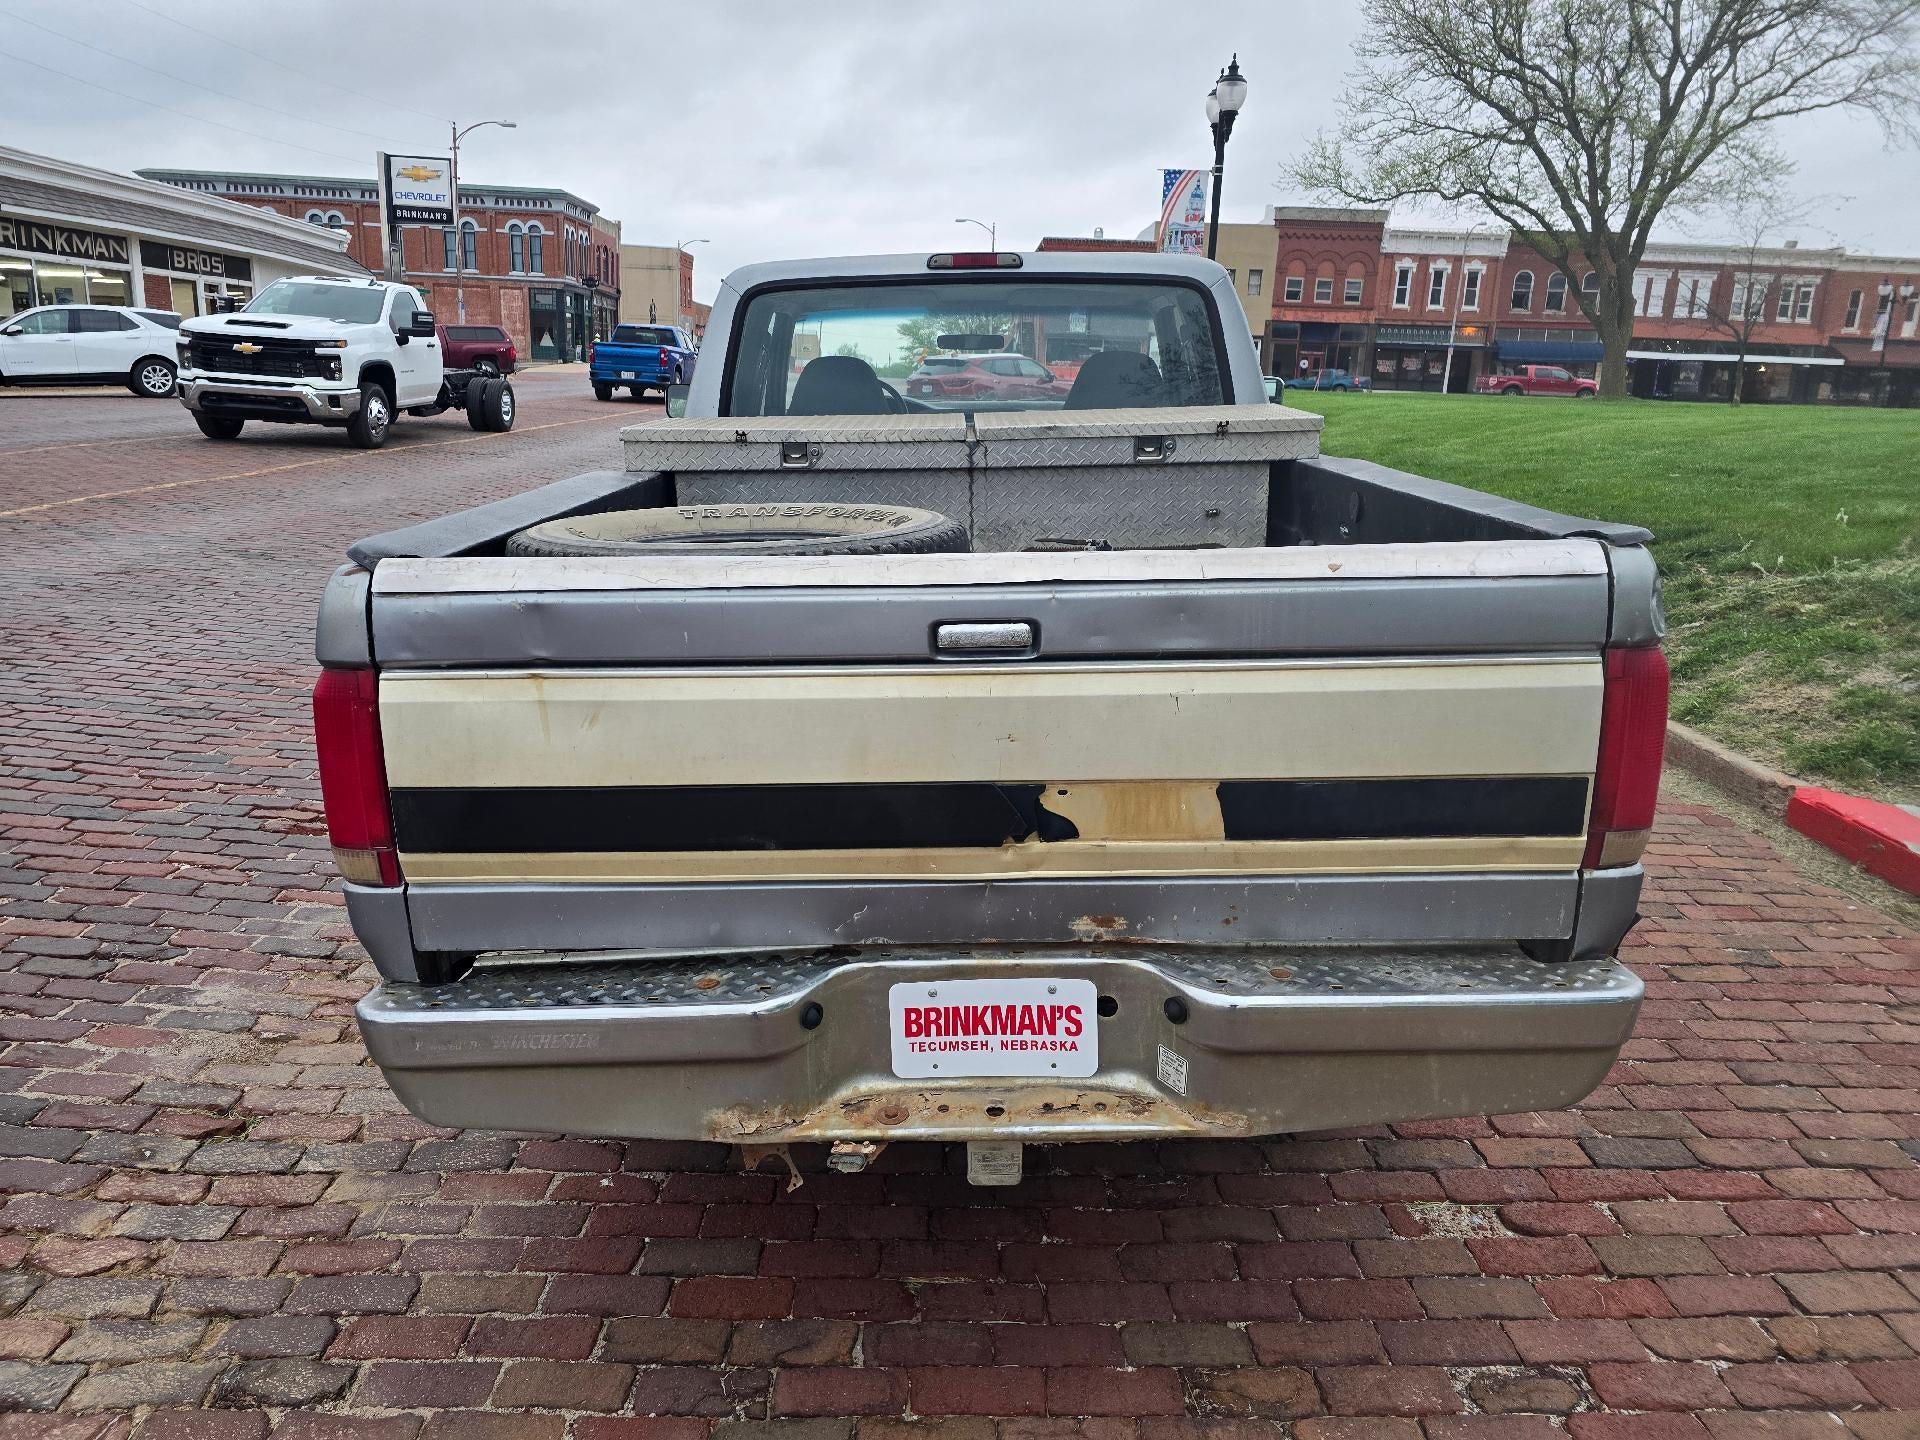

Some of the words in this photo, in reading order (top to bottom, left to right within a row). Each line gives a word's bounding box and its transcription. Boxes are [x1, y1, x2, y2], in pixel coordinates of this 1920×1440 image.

[395, 191, 447, 203] CHEVROLET
[396, 209, 447, 221] BRINKMAN'S
[174, 249, 223, 274] BROS
[904, 1004, 1083, 1039] BRINKMAN'S
[909, 1040, 995, 1053] TECUMSEH,
[1000, 1039, 1079, 1052] NEBRASKA
